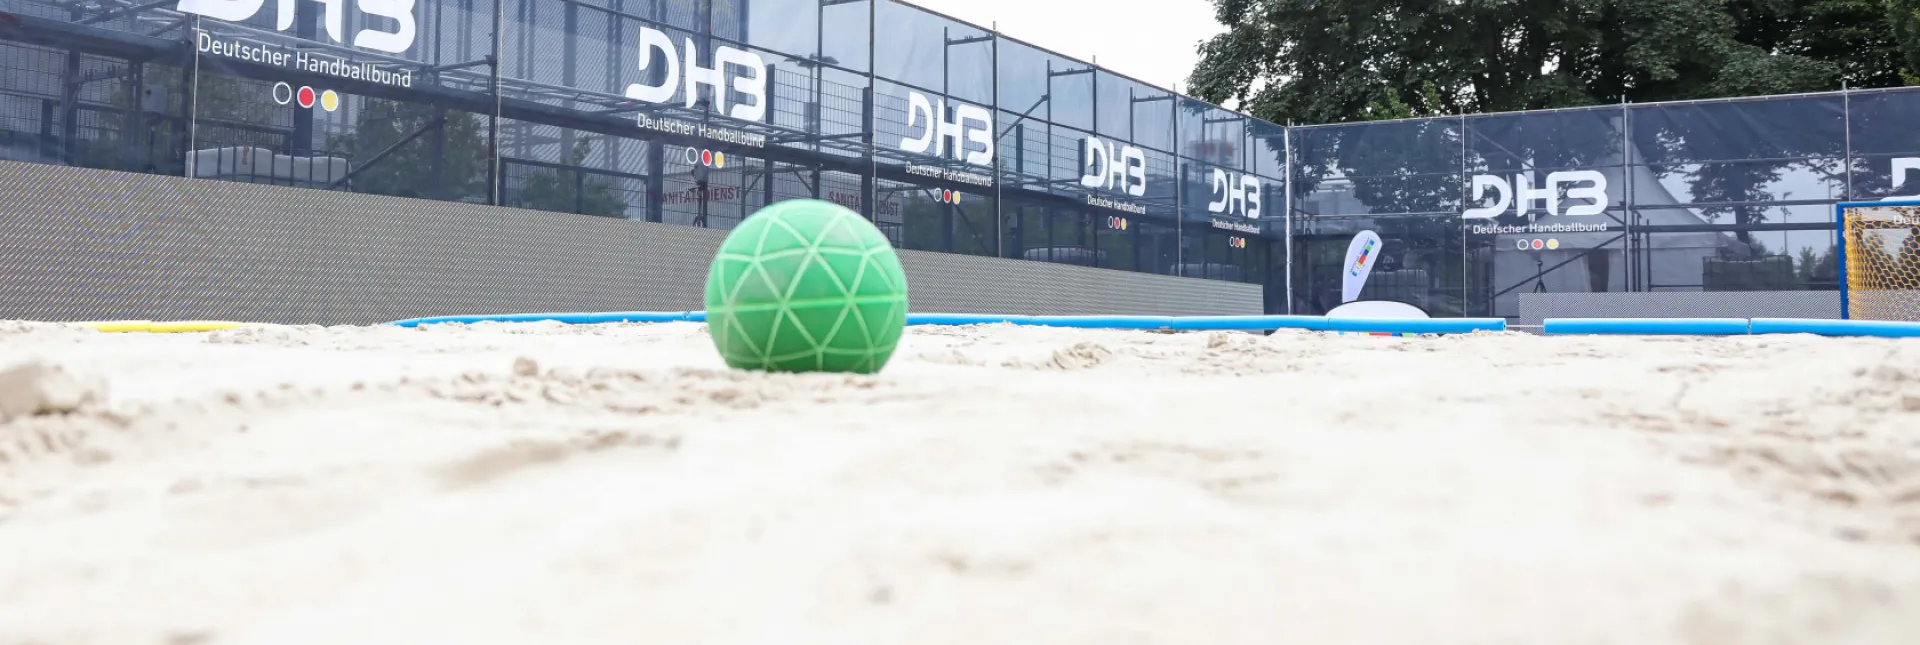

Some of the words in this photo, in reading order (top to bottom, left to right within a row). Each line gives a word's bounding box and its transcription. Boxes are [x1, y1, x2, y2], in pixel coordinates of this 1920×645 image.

[198, 32, 291, 67] Deutscher
[296, 52, 411, 88] Handballbund
[625, 26, 767, 121] DHB
[637, 112, 696, 136] Deutscher
[698, 123, 765, 149] Handballbund
[900, 91, 994, 166] DHB
[905, 160, 942, 179] Deutscher
[943, 168, 993, 188] Handballbund
[1081, 135, 1146, 197] DHB
[1087, 194, 1113, 208] Deutscher
[1208, 167, 1261, 219] DHB
[1462, 170, 1608, 219] DHB
[1473, 223, 1526, 235] Deutscher
[1529, 222, 1608, 233] Handballbund
